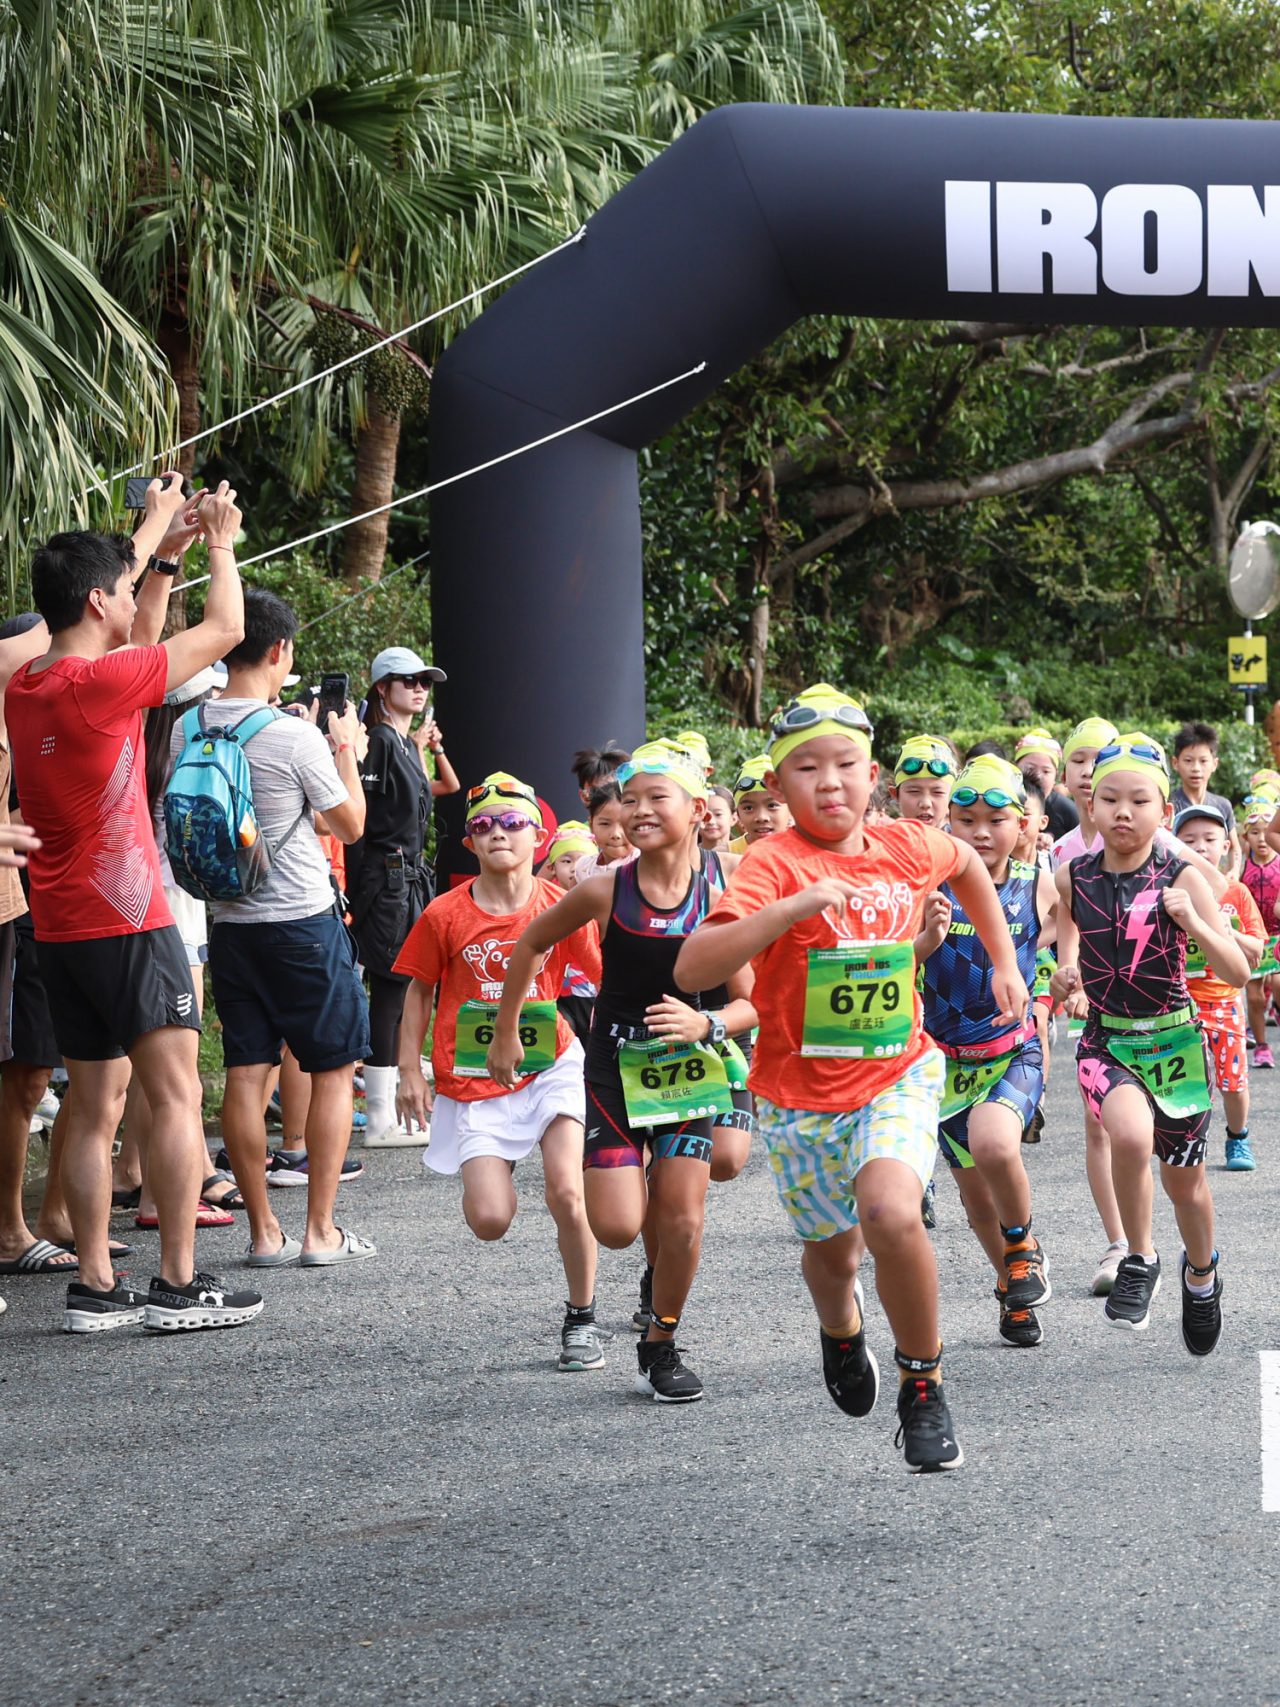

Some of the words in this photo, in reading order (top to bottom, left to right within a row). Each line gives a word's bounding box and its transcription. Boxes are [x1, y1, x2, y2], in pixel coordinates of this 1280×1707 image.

[830, 980, 901, 1015] 679
[474, 1025, 538, 1047] 68
[640, 1058, 706, 1090] 678
[179, 1296, 226, 1309] RUNN
